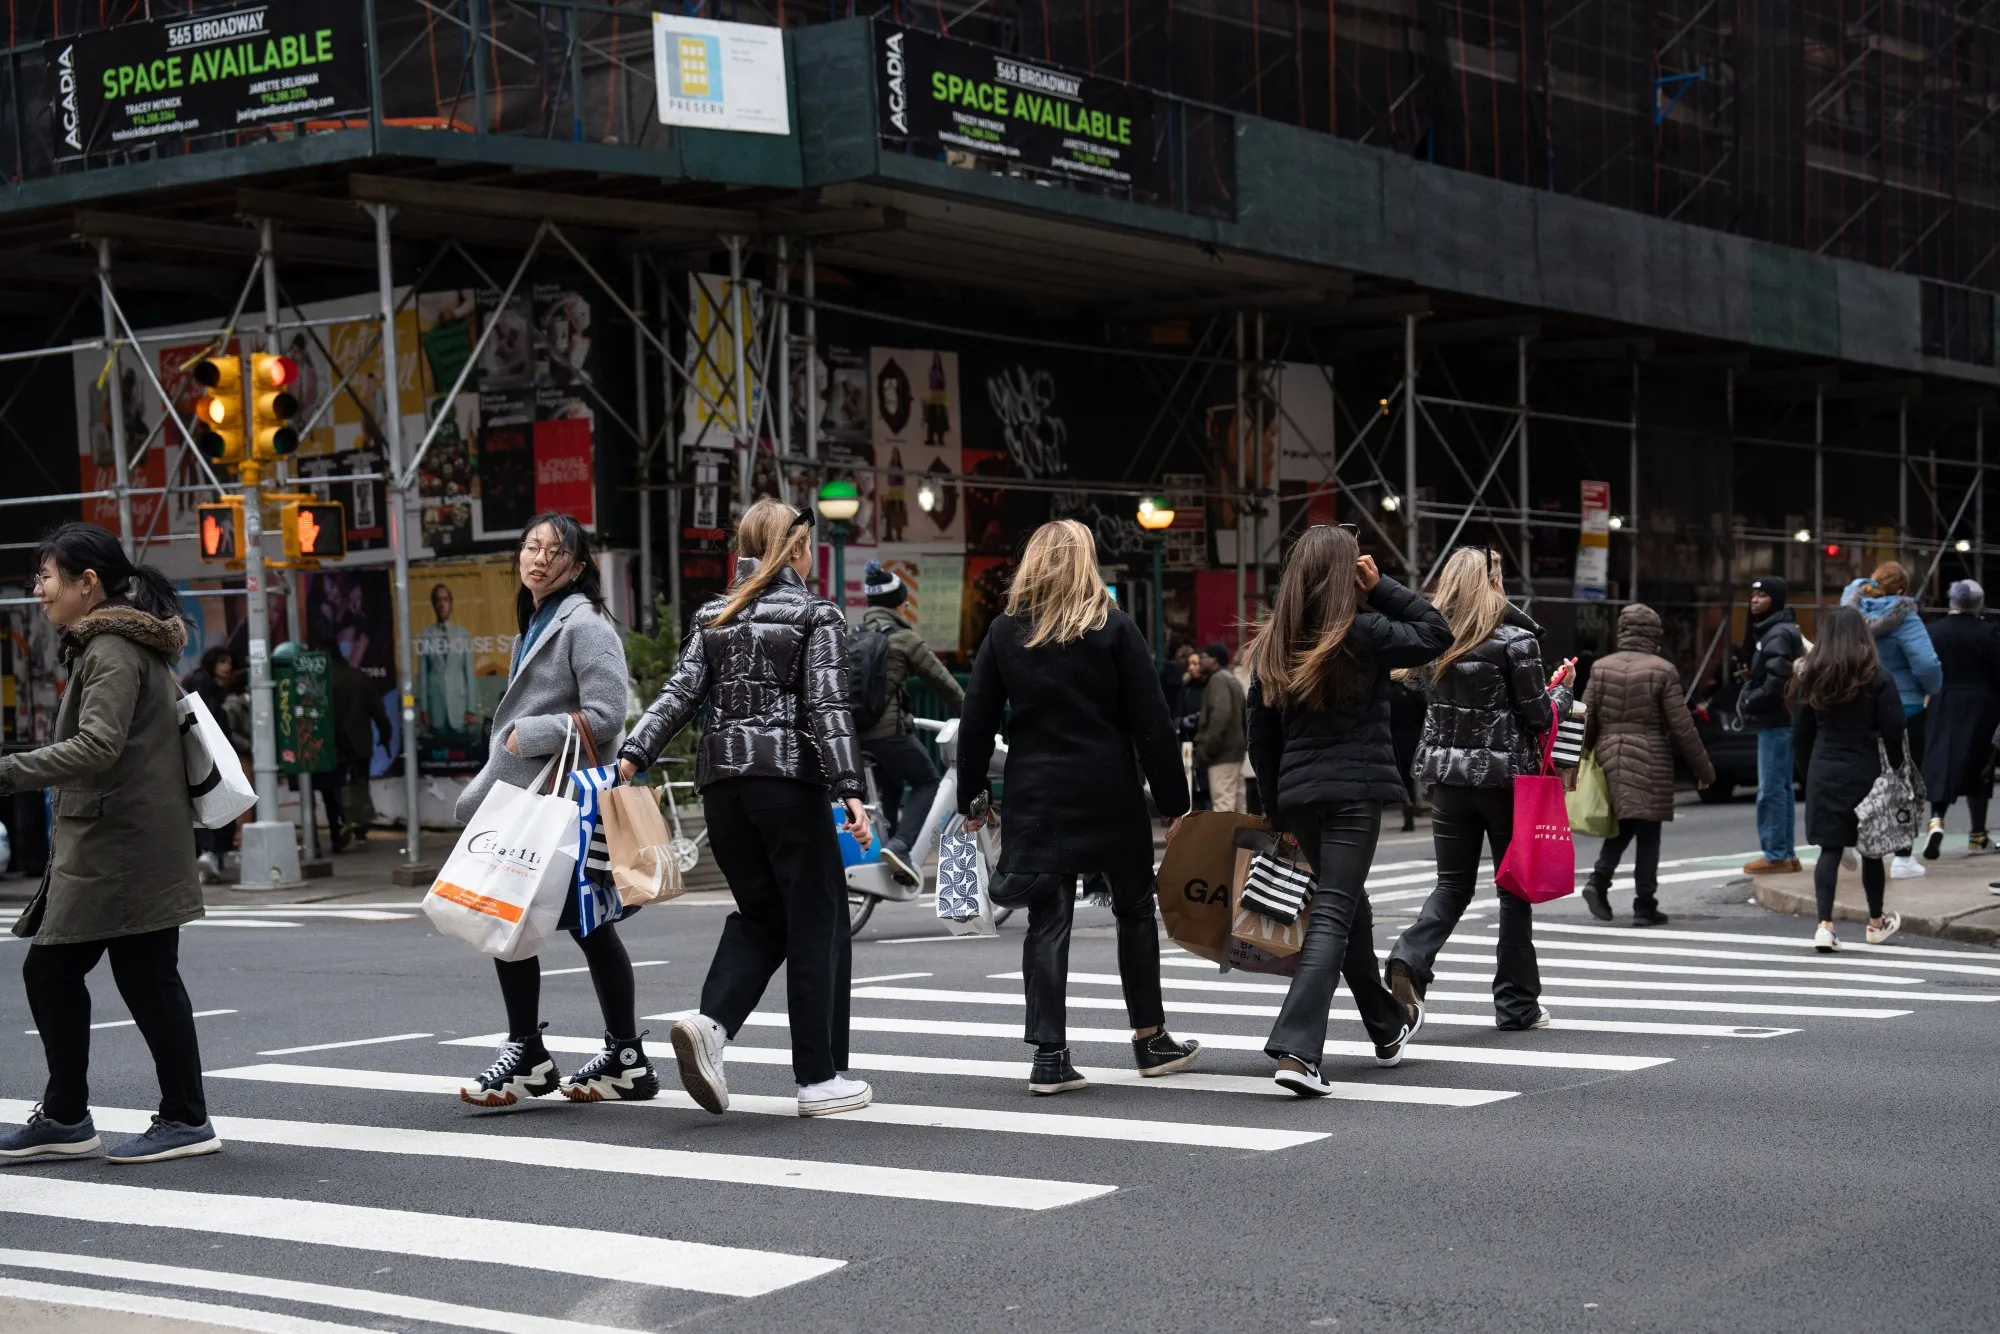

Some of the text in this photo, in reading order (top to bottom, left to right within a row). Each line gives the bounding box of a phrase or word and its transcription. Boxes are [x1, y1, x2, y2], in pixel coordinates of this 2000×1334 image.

[168, 11, 265, 46] 565 BROADWAY
[102, 56, 184, 100] SPACE
[190, 28, 334, 84] AVAILABLE
[996, 61, 1081, 98] 565 BROADWAY
[58, 43, 82, 149] ACADIA
[886, 32, 908, 134] ACADIA
[669, 100, 725, 115] PRESERV
[931, 71, 1010, 116] SPACE
[1013, 92, 1132, 145] AVAILABLE
[538, 456, 585, 470] LOYAL
[411, 636, 493, 656] TONEHOUSE
[1184, 879, 1228, 907] GA
